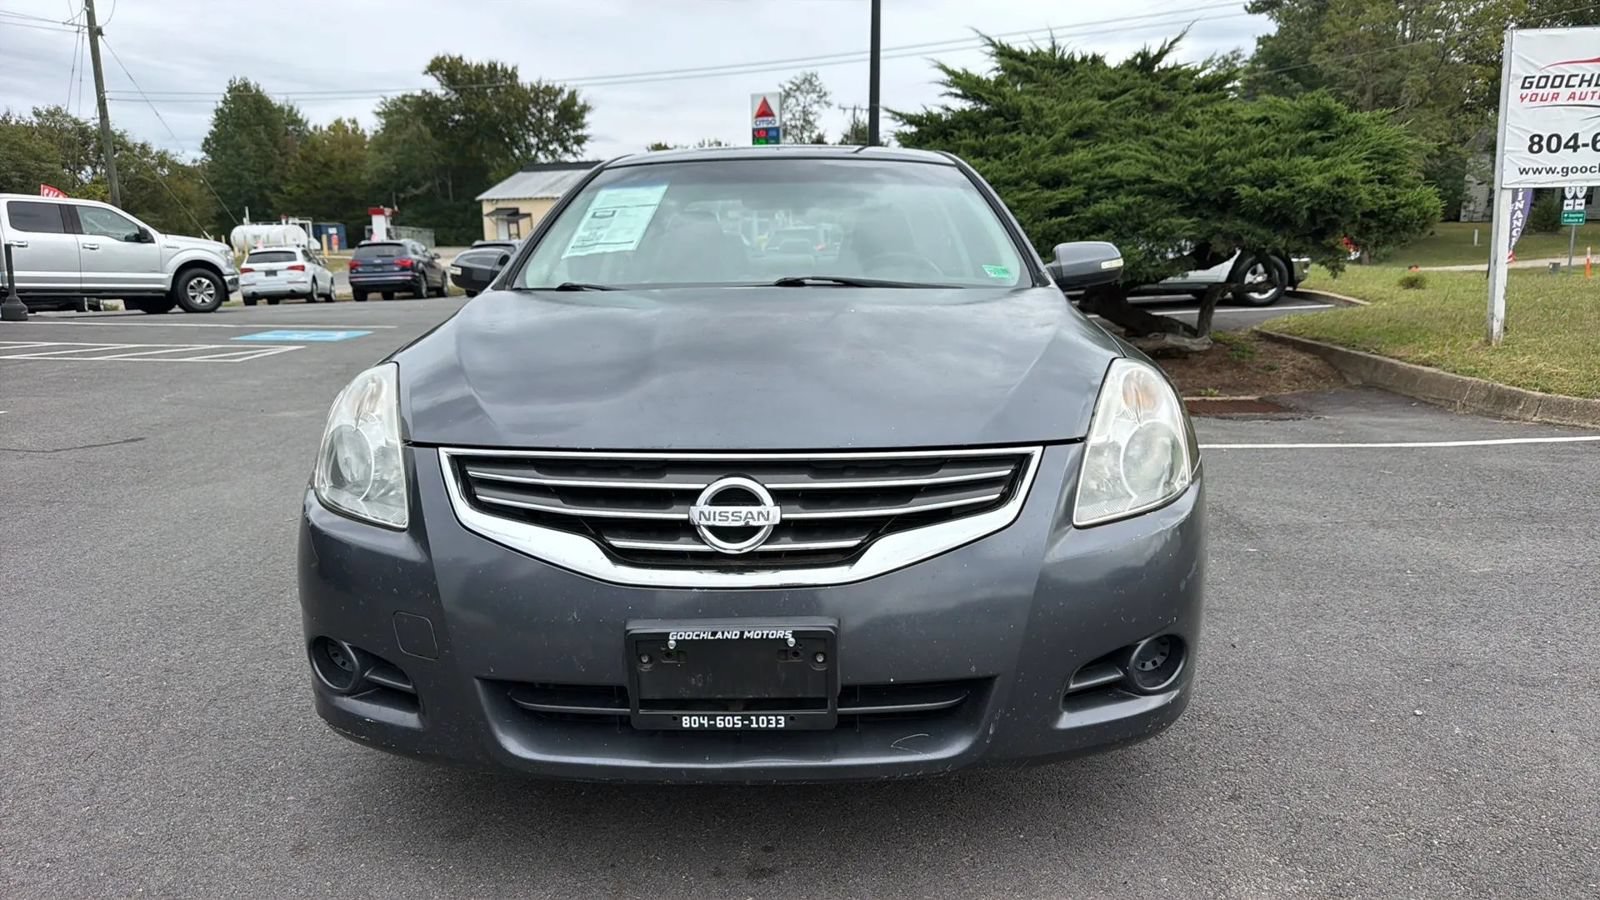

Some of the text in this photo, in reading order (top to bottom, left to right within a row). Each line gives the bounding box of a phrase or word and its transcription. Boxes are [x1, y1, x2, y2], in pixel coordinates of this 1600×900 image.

[1519, 90, 1600, 103] YOUR AUT
[1518, 163, 1600, 177] www.gooc
[699, 510, 770, 522] NISSAN
[668, 630, 793, 640] GOOCHLAND MOTORS
[682, 716, 785, 728] 804-605-1033
